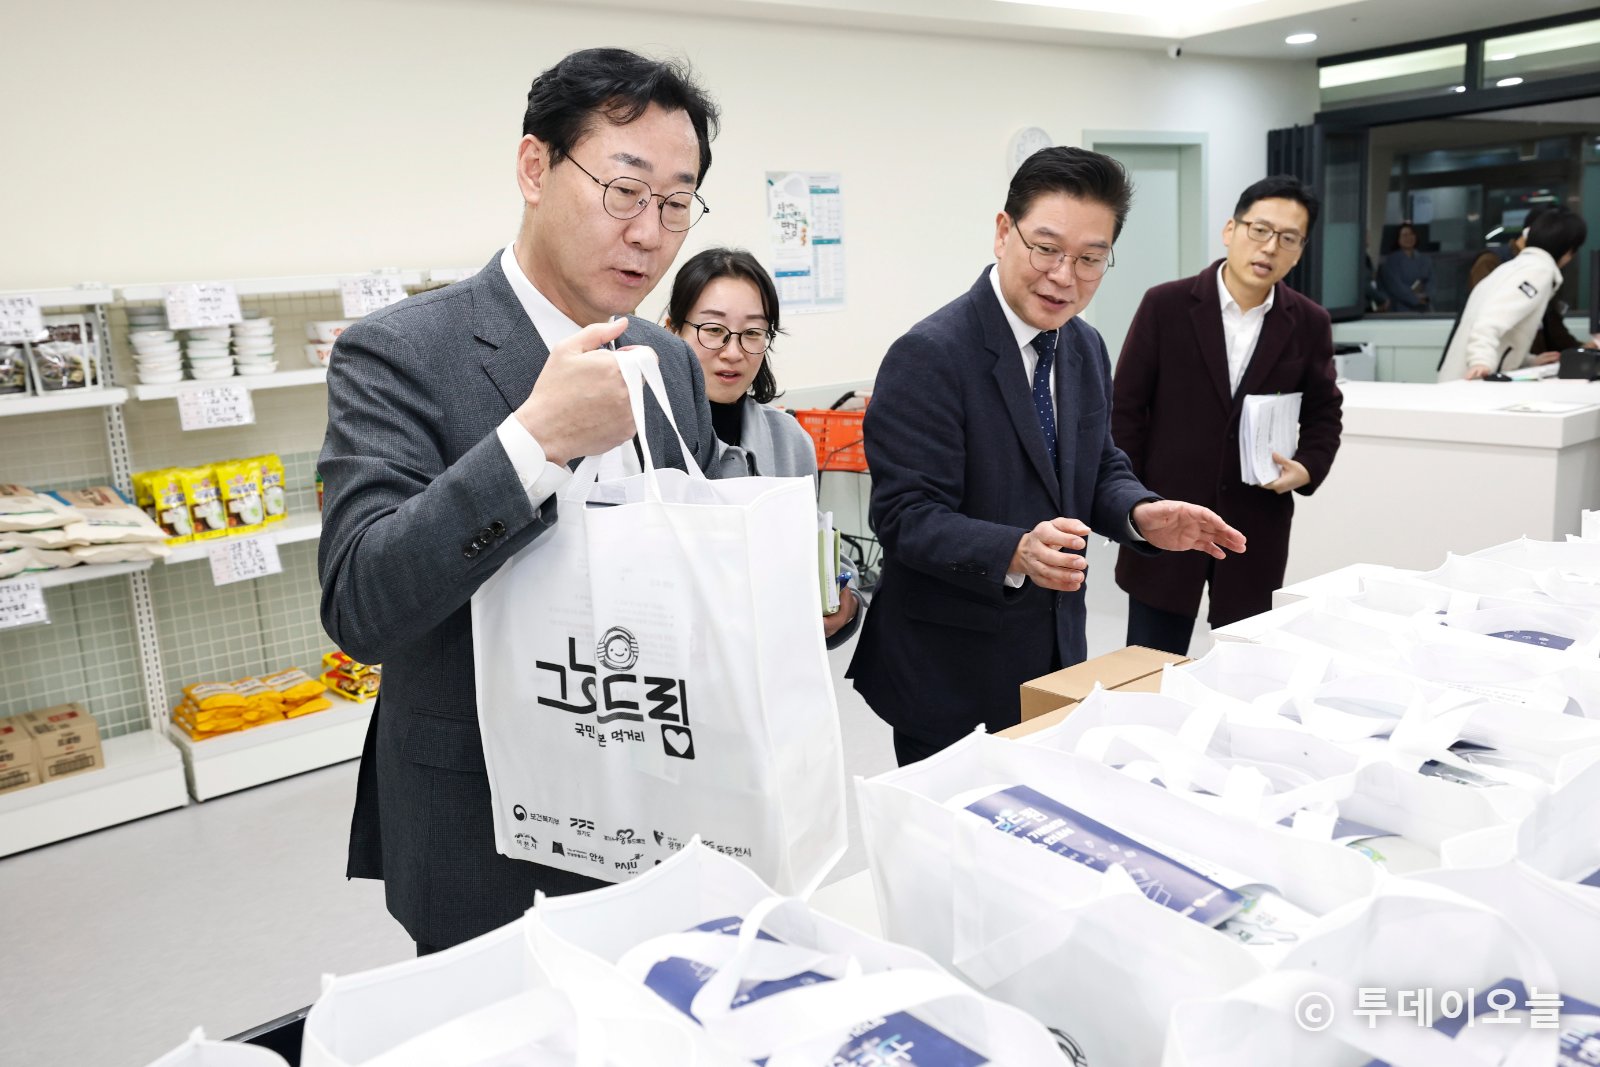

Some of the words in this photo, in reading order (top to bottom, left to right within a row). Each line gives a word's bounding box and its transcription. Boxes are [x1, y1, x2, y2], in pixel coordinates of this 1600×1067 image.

[574, 722, 595, 739] 국민
[611, 729, 646, 743] 먹거리
[530, 812, 560, 826] 보건복지부
[576, 829, 592, 838] 경기도
[667, 841, 685, 851] 광명
[717, 844, 752, 858] 동두천시
[589, 852, 605, 865] 안성
[614, 861, 638, 871] PAJU
